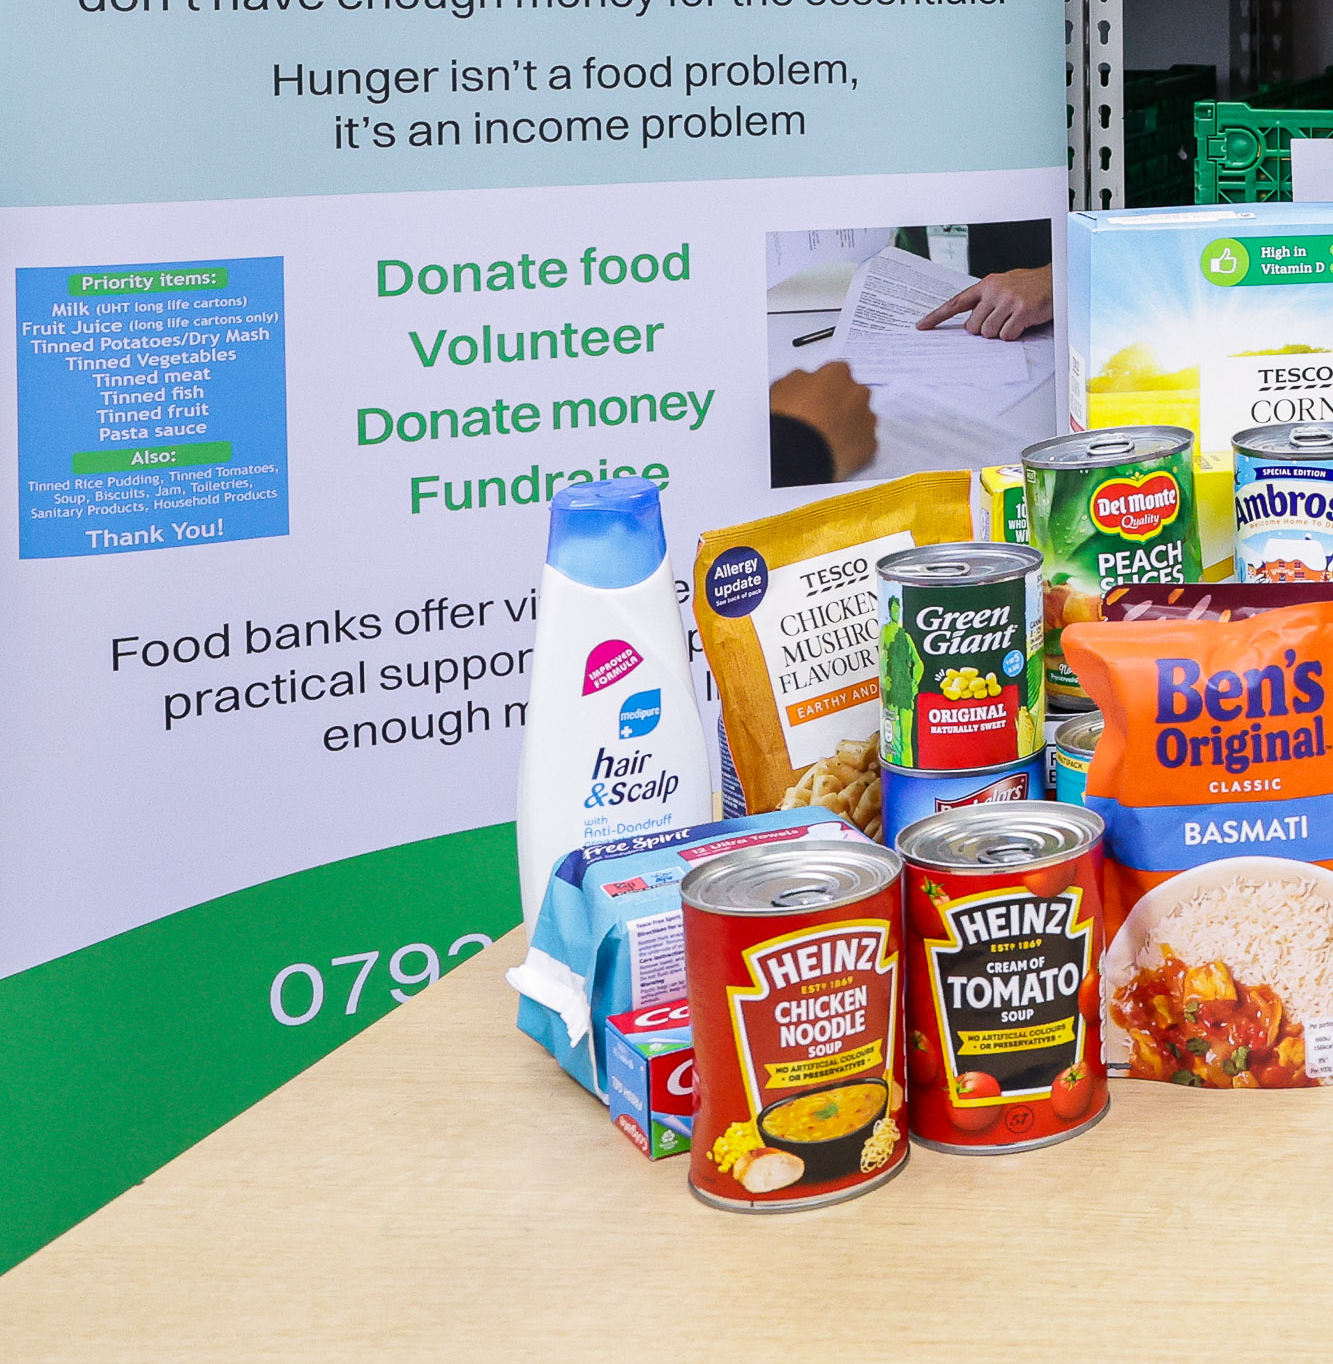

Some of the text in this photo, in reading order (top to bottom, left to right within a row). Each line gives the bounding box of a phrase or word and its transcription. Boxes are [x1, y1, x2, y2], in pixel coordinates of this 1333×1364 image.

[1261, 246, 1307, 260] High in
[82, 273, 216, 291] Priority items:
[378, 245, 691, 300] Donate food
[1261, 262, 1325, 275] Vitamin D
[52, 304, 89, 316] Milk
[65, 349, 236, 371] Tinned Vegetables
[407, 321, 665, 369] Volunteer
[1258, 366, 1333, 384] TESCO
[358, 386, 715, 446] Donate money
[100, 423, 207, 441] Pasta sauce
[1262, 467, 1326, 477] SPECIAL EDITION
[1097, 488, 1176, 517] Del Monte
[86, 518, 224, 548] Thank You!
[1121, 513, 1160, 529] Quality
[1098, 541, 1183, 576] PEACH
[800, 558, 867, 590] TESCO
[916, 605, 1010, 631] Green
[923, 624, 1016, 655] Giant
[1157, 715, 1326, 774] Original
[591, 748, 653, 780] hair
[1209, 778, 1282, 793] CLASSIC
[1185, 816, 1308, 846] BASMATI
[959, 904, 1067, 941] HEINZ
[767, 939, 877, 990] HEINZ
[947, 963, 1079, 1009] TOMATO
[774, 985, 867, 1024] CHICKEN
[1001, 1009, 1034, 1023] SOUP
[780, 1010, 865, 1048] NOODLE
[808, 1041, 842, 1058] SOUP
